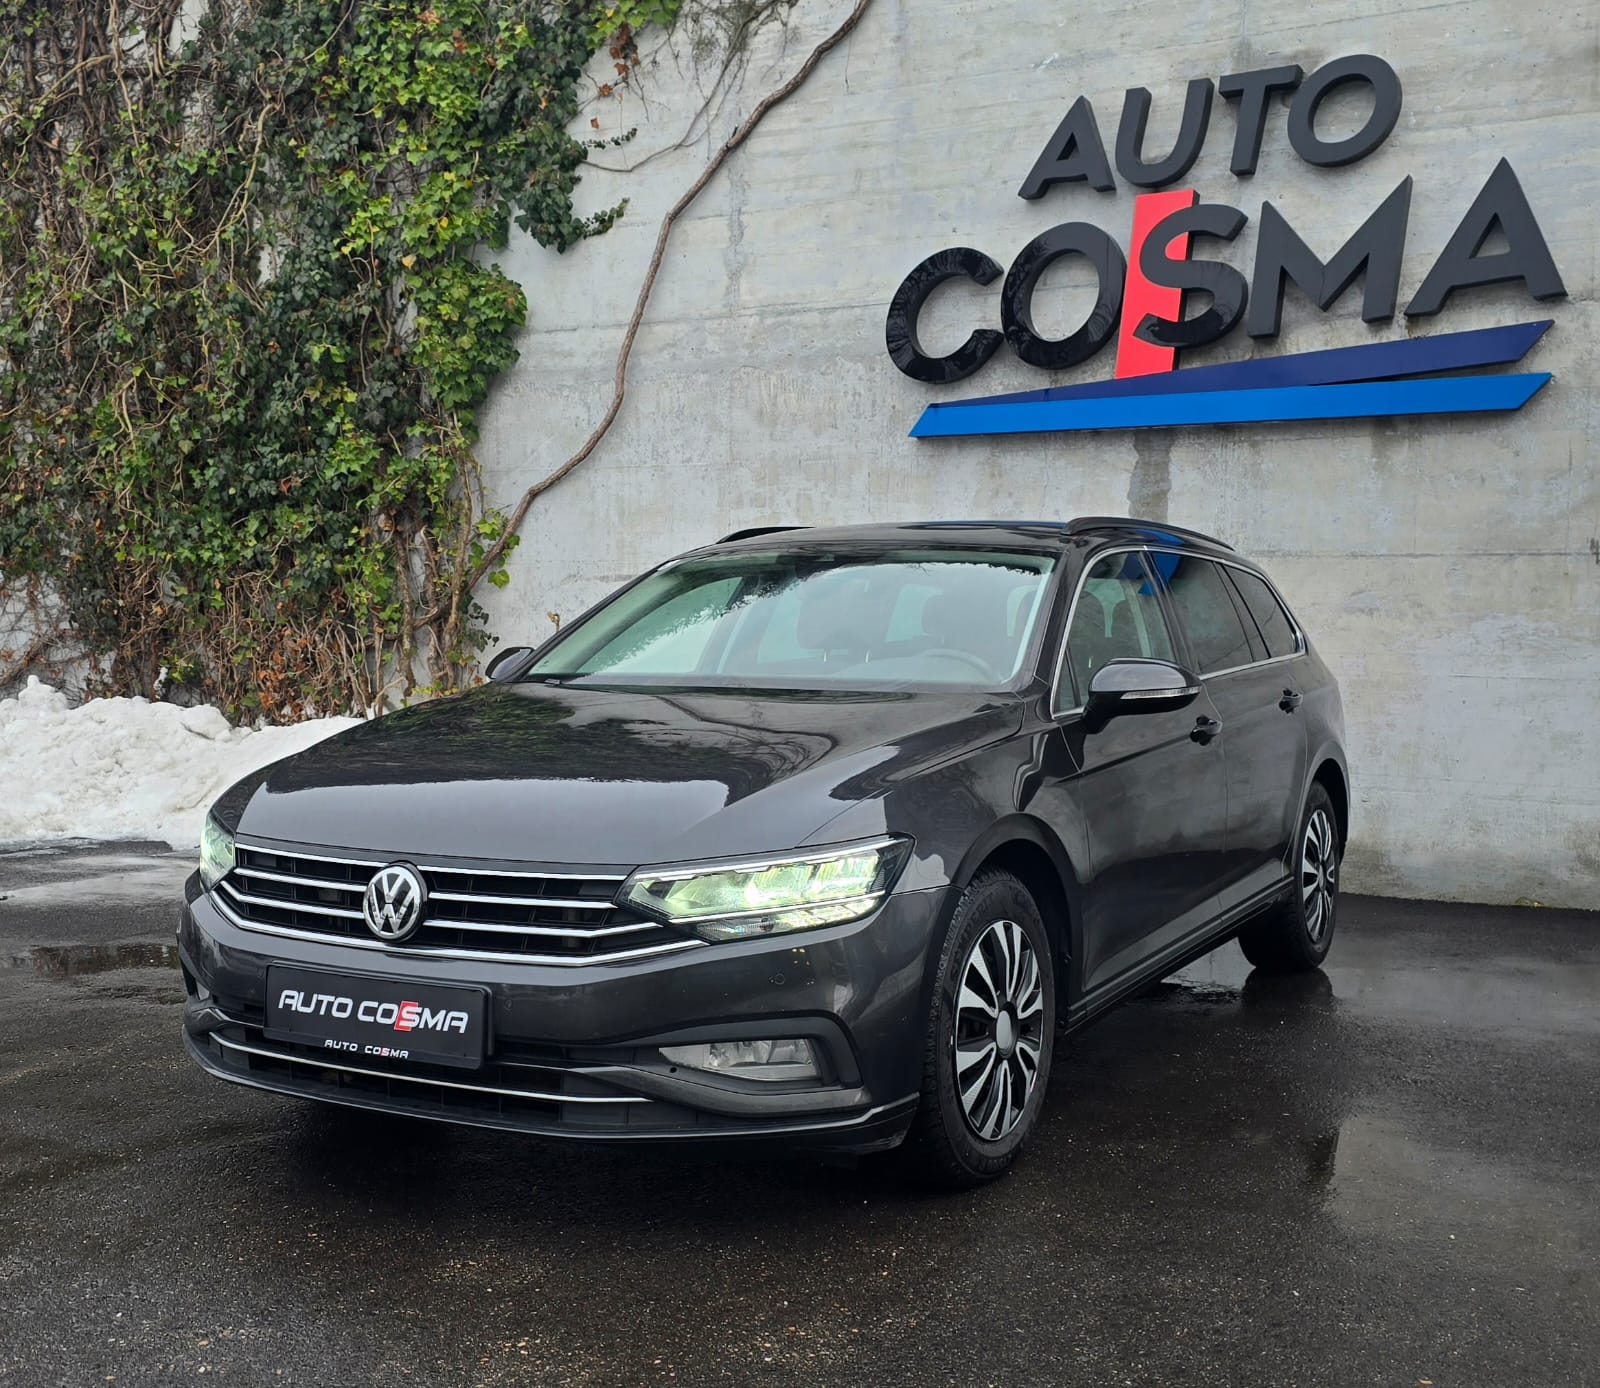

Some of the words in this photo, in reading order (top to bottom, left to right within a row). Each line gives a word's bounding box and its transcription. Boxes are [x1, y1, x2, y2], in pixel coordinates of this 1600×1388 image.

[1018, 54, 1402, 199] AUTO
[886, 156, 1568, 384] COSMA
[278, 989, 353, 1019] AUTO
[357, 1000, 469, 1034] COSMA
[324, 1039, 359, 1052] AUTO
[364, 1045, 409, 1059] COSMA
